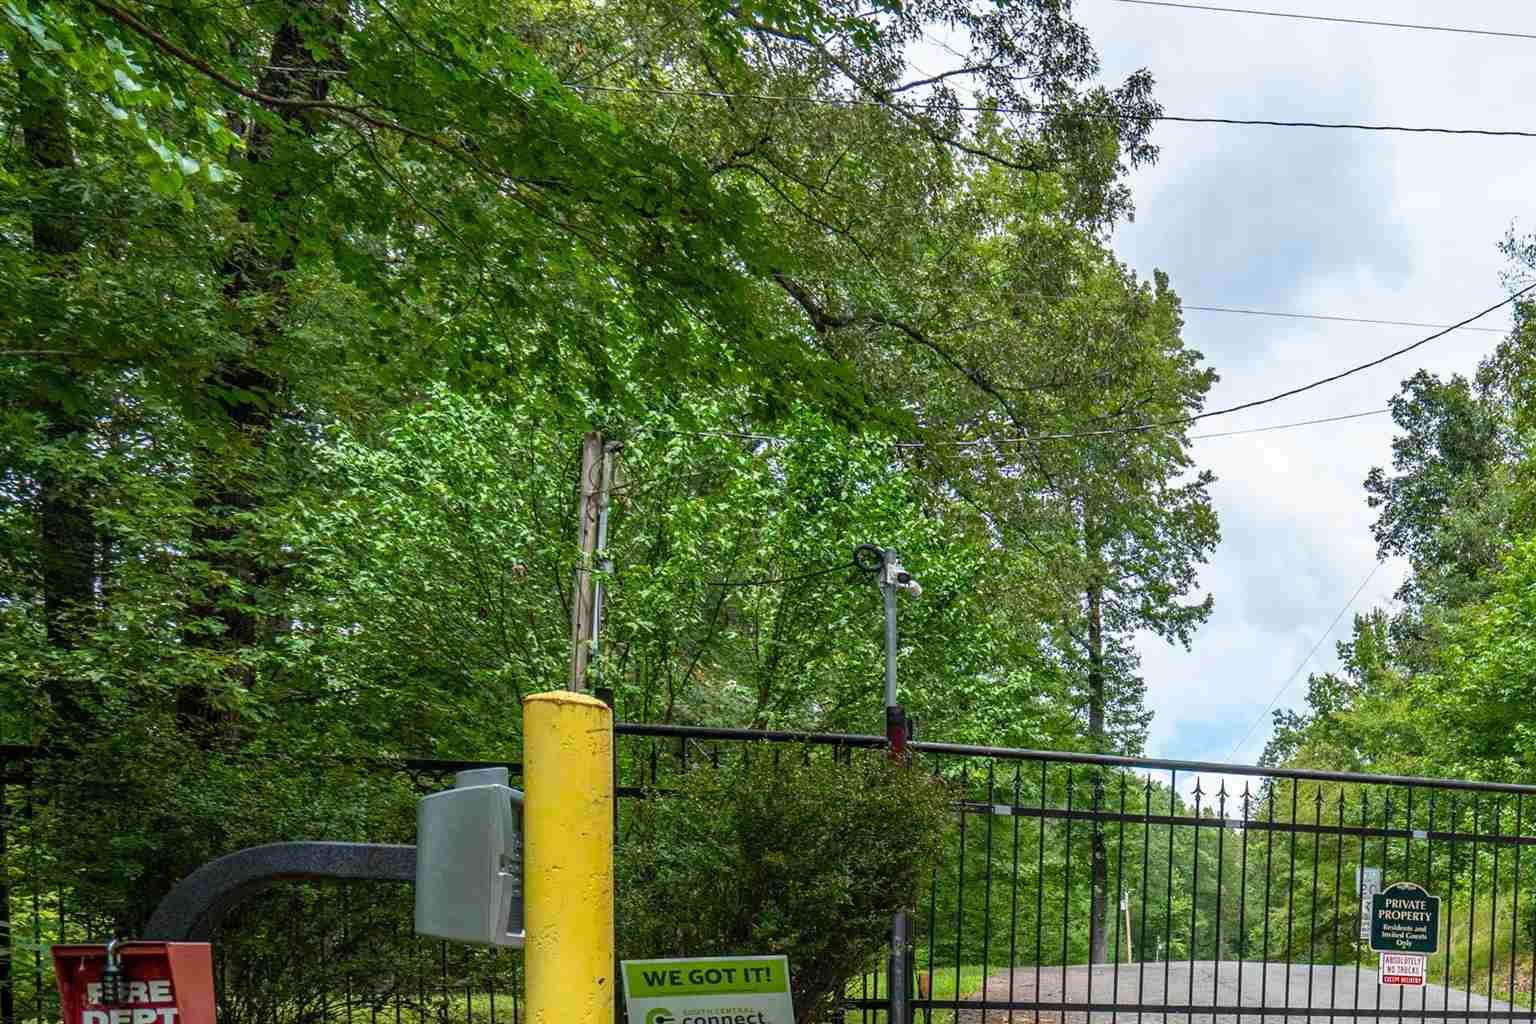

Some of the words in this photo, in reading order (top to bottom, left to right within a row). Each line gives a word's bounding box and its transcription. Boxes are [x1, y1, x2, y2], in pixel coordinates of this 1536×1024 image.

[1385, 898, 1427, 910] PRIVATE
[1378, 909, 1432, 921] PROPERTY
[643, 969, 684, 987] WE
[688, 968, 737, 985] GOT
[744, 967, 772, 984] IT!
[87, 980, 173, 1005] FRE
